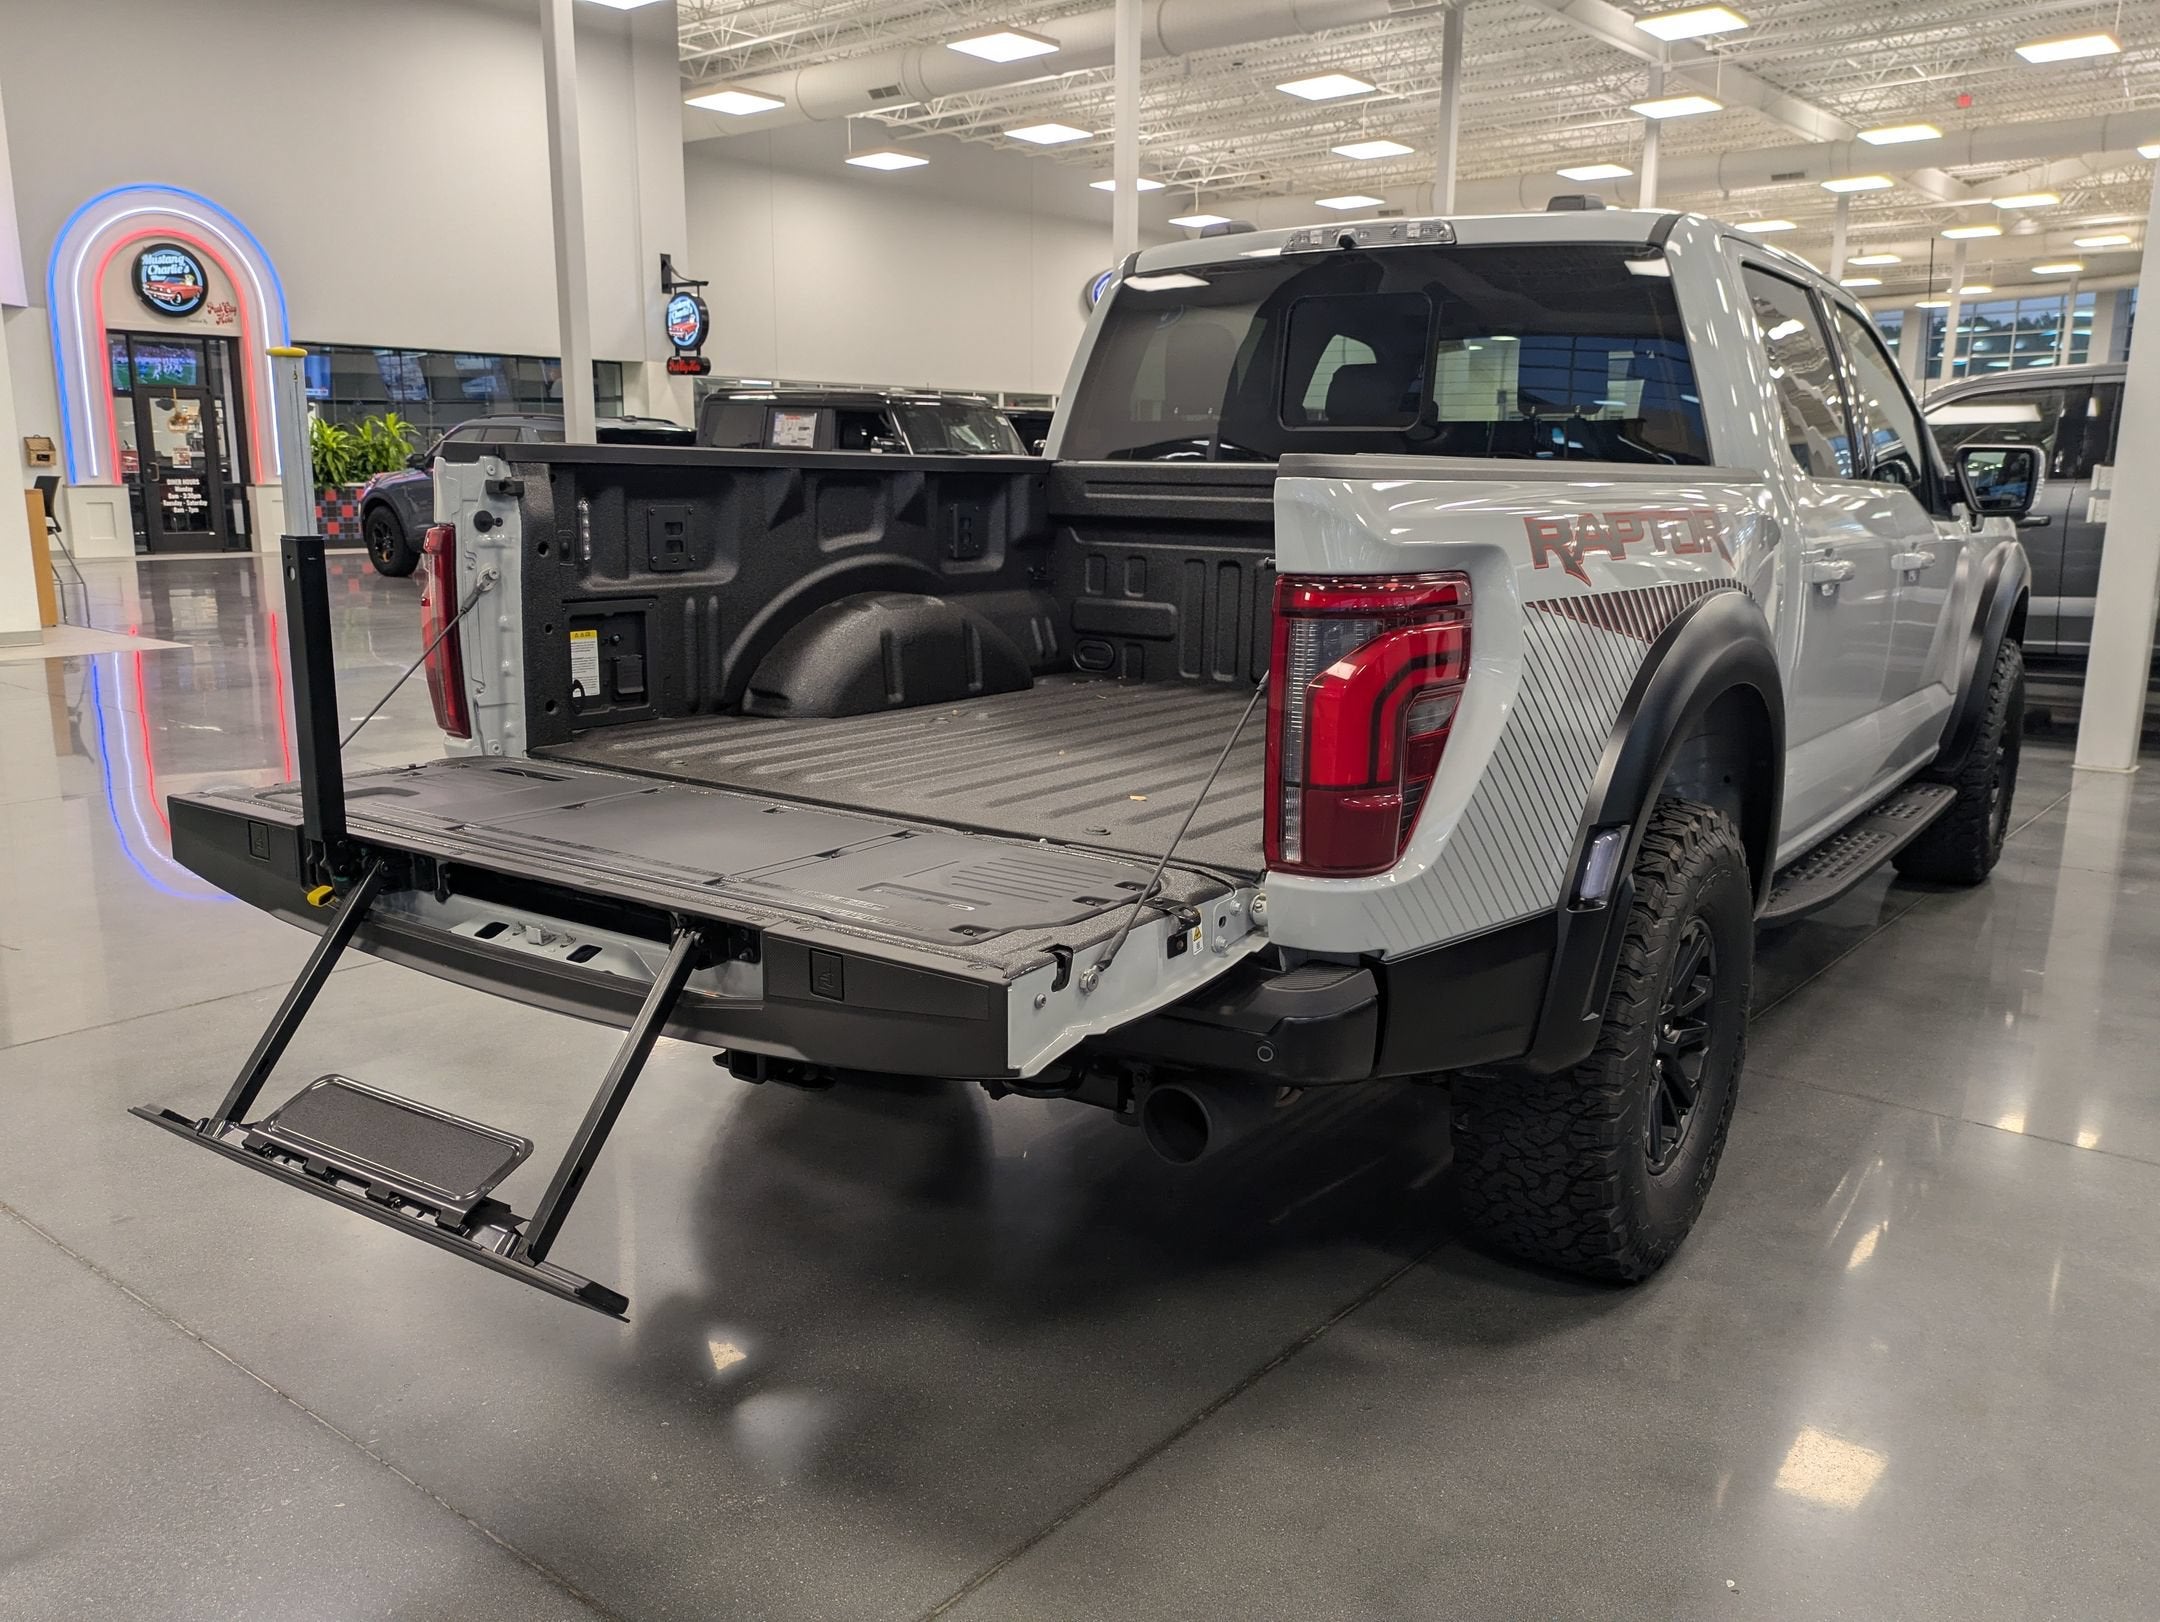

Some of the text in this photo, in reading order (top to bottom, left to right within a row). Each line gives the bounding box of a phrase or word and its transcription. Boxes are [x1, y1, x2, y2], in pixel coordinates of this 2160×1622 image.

[142, 254, 185, 266] Mustang
[147, 264, 190, 275] Charlie's
[1523, 510, 1736, 587] RAPTOR
